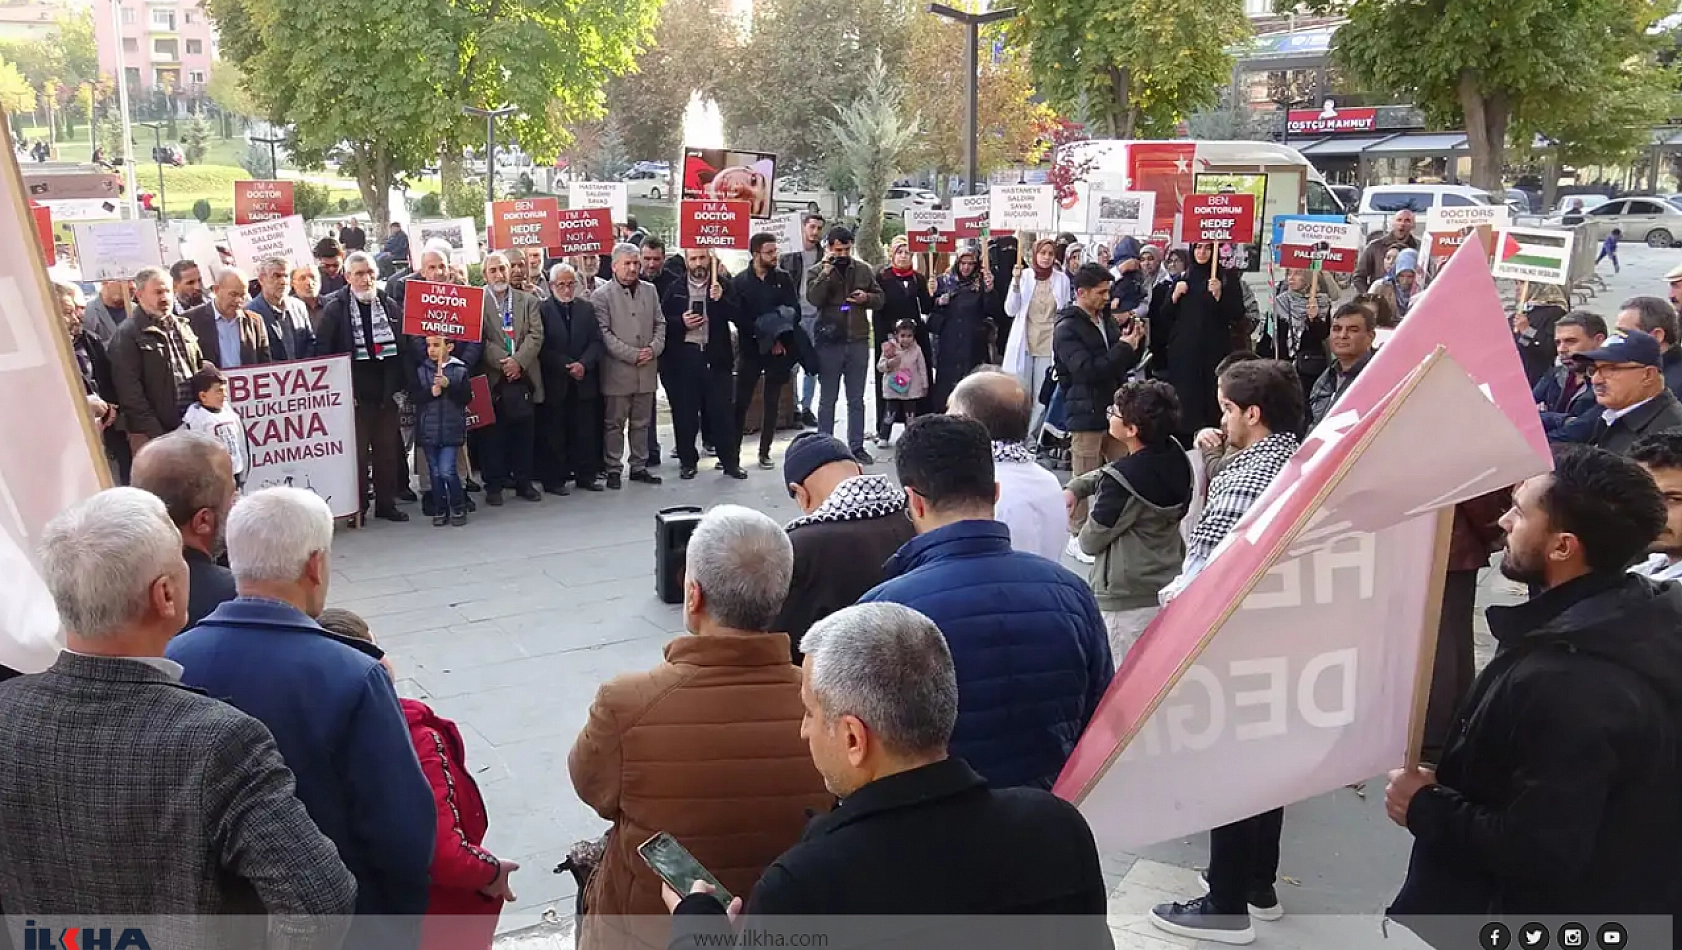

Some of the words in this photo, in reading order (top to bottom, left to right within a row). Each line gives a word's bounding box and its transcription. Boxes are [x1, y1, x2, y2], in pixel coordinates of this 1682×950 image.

[1327, 118, 1373, 129] MAHMUT
[268, 182, 275, 190] A
[579, 184, 617, 192] HASTANEYE
[1001, 187, 1042, 195] HASTANEYE
[246, 190, 282, 199] DOCTOR
[1006, 195, 1036, 203] SALDIRI
[252, 203, 267, 211] NOT
[270, 202, 277, 211] A
[515, 201, 534, 211] BEN
[702, 202, 716, 211] I'M
[720, 202, 729, 211] A
[1208, 196, 1229, 206] BEN
[1010, 203, 1033, 211] SAVAŞ
[1193, 206, 1243, 215] DOKTORUM
[503, 210, 547, 220] DOKTORUM
[565, 211, 579, 220] I'M
[582, 211, 591, 219] A
[694, 211, 736, 220] DOCTOR
[913, 211, 947, 221] DOCTORS
[1003, 210, 1038, 219] SUÇUDUR
[1440, 208, 1495, 219] DOCTORS
[559, 219, 599, 230] DOCTOR
[1200, 218, 1236, 229] HEDEF
[1445, 217, 1469, 225] STAND
[240, 221, 290, 237] HASTANEYE
[510, 223, 542, 234] HEDEF
[701, 225, 719, 234] NOT
[721, 225, 729, 234] A
[1201, 227, 1233, 240] DEĞİL
[1296, 223, 1348, 236] DOCTORS
[251, 232, 285, 244] SALDIRI
[512, 233, 541, 245] DEĞİL
[566, 232, 585, 242] NOT
[586, 231, 595, 240] A
[694, 235, 736, 246] TARGET!
[915, 235, 948, 244] PALESTINE
[562, 242, 601, 253] TARGET!
[1292, 249, 1343, 262] PALESTINE
[430, 284, 446, 295] I'M
[450, 286, 459, 296] A
[421, 293, 467, 308] DOCTOR
[427, 309, 449, 320] NOT
[450, 311, 459, 322] A
[421, 321, 465, 335] TARGET!
[228, 364, 331, 404] BEYAZ
[233, 390, 343, 419] NLÜKLERİMİZ
[246, 411, 329, 448] KANA
[252, 440, 344, 468] LANMASIN
